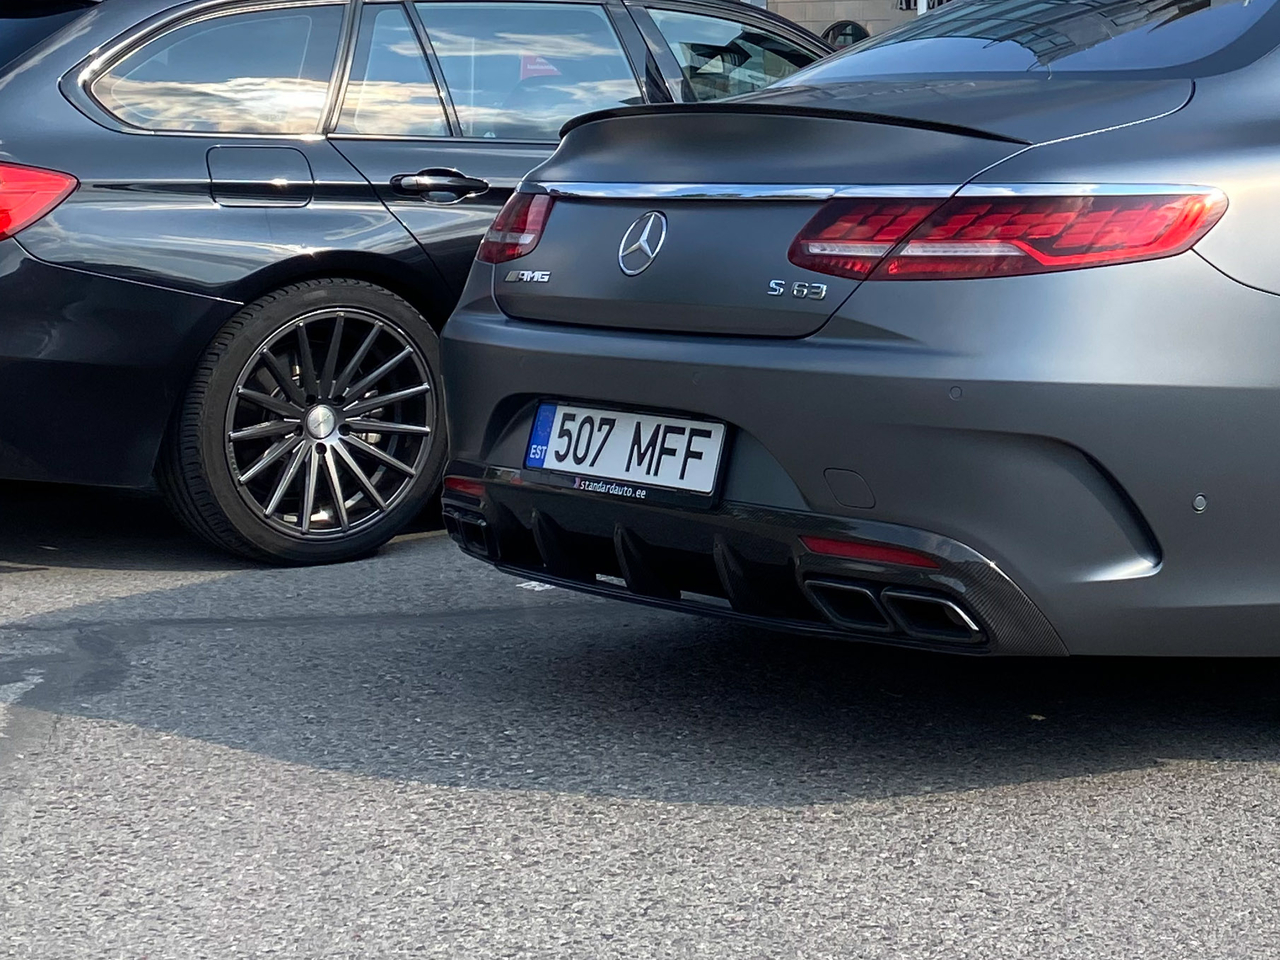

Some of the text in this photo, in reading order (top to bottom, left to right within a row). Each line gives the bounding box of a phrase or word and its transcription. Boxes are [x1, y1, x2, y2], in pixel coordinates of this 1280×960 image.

[516, 270, 551, 282] AMG
[767, 279, 828, 300] S 63
[529, 445, 548, 460] EST
[554, 412, 713, 481] 507 MFF
[580, 479, 647, 499] standardauto.ee
